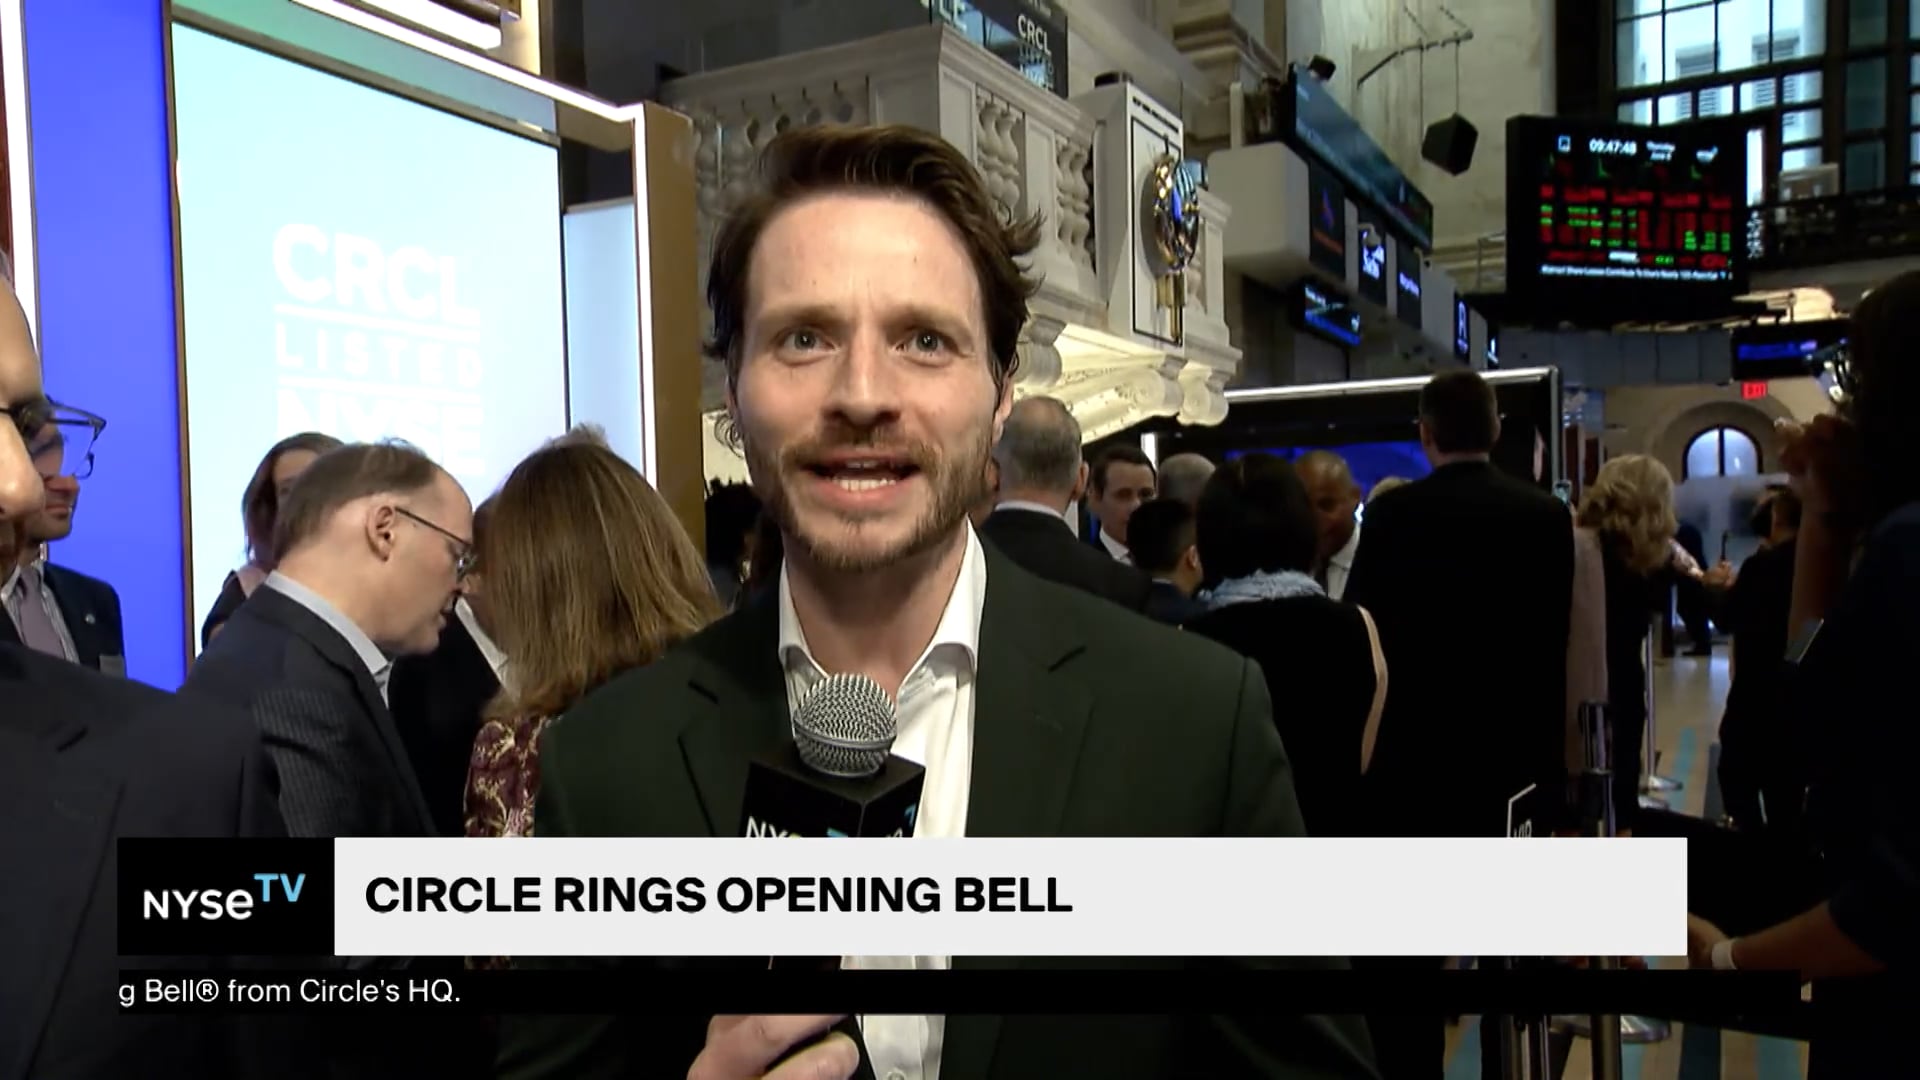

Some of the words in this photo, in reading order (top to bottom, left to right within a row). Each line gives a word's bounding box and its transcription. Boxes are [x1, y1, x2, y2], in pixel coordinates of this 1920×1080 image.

[1017, 13, 1052, 56] CRCL
[272, 223, 480, 327] CRCL
[275, 320, 483, 388] LISTED
